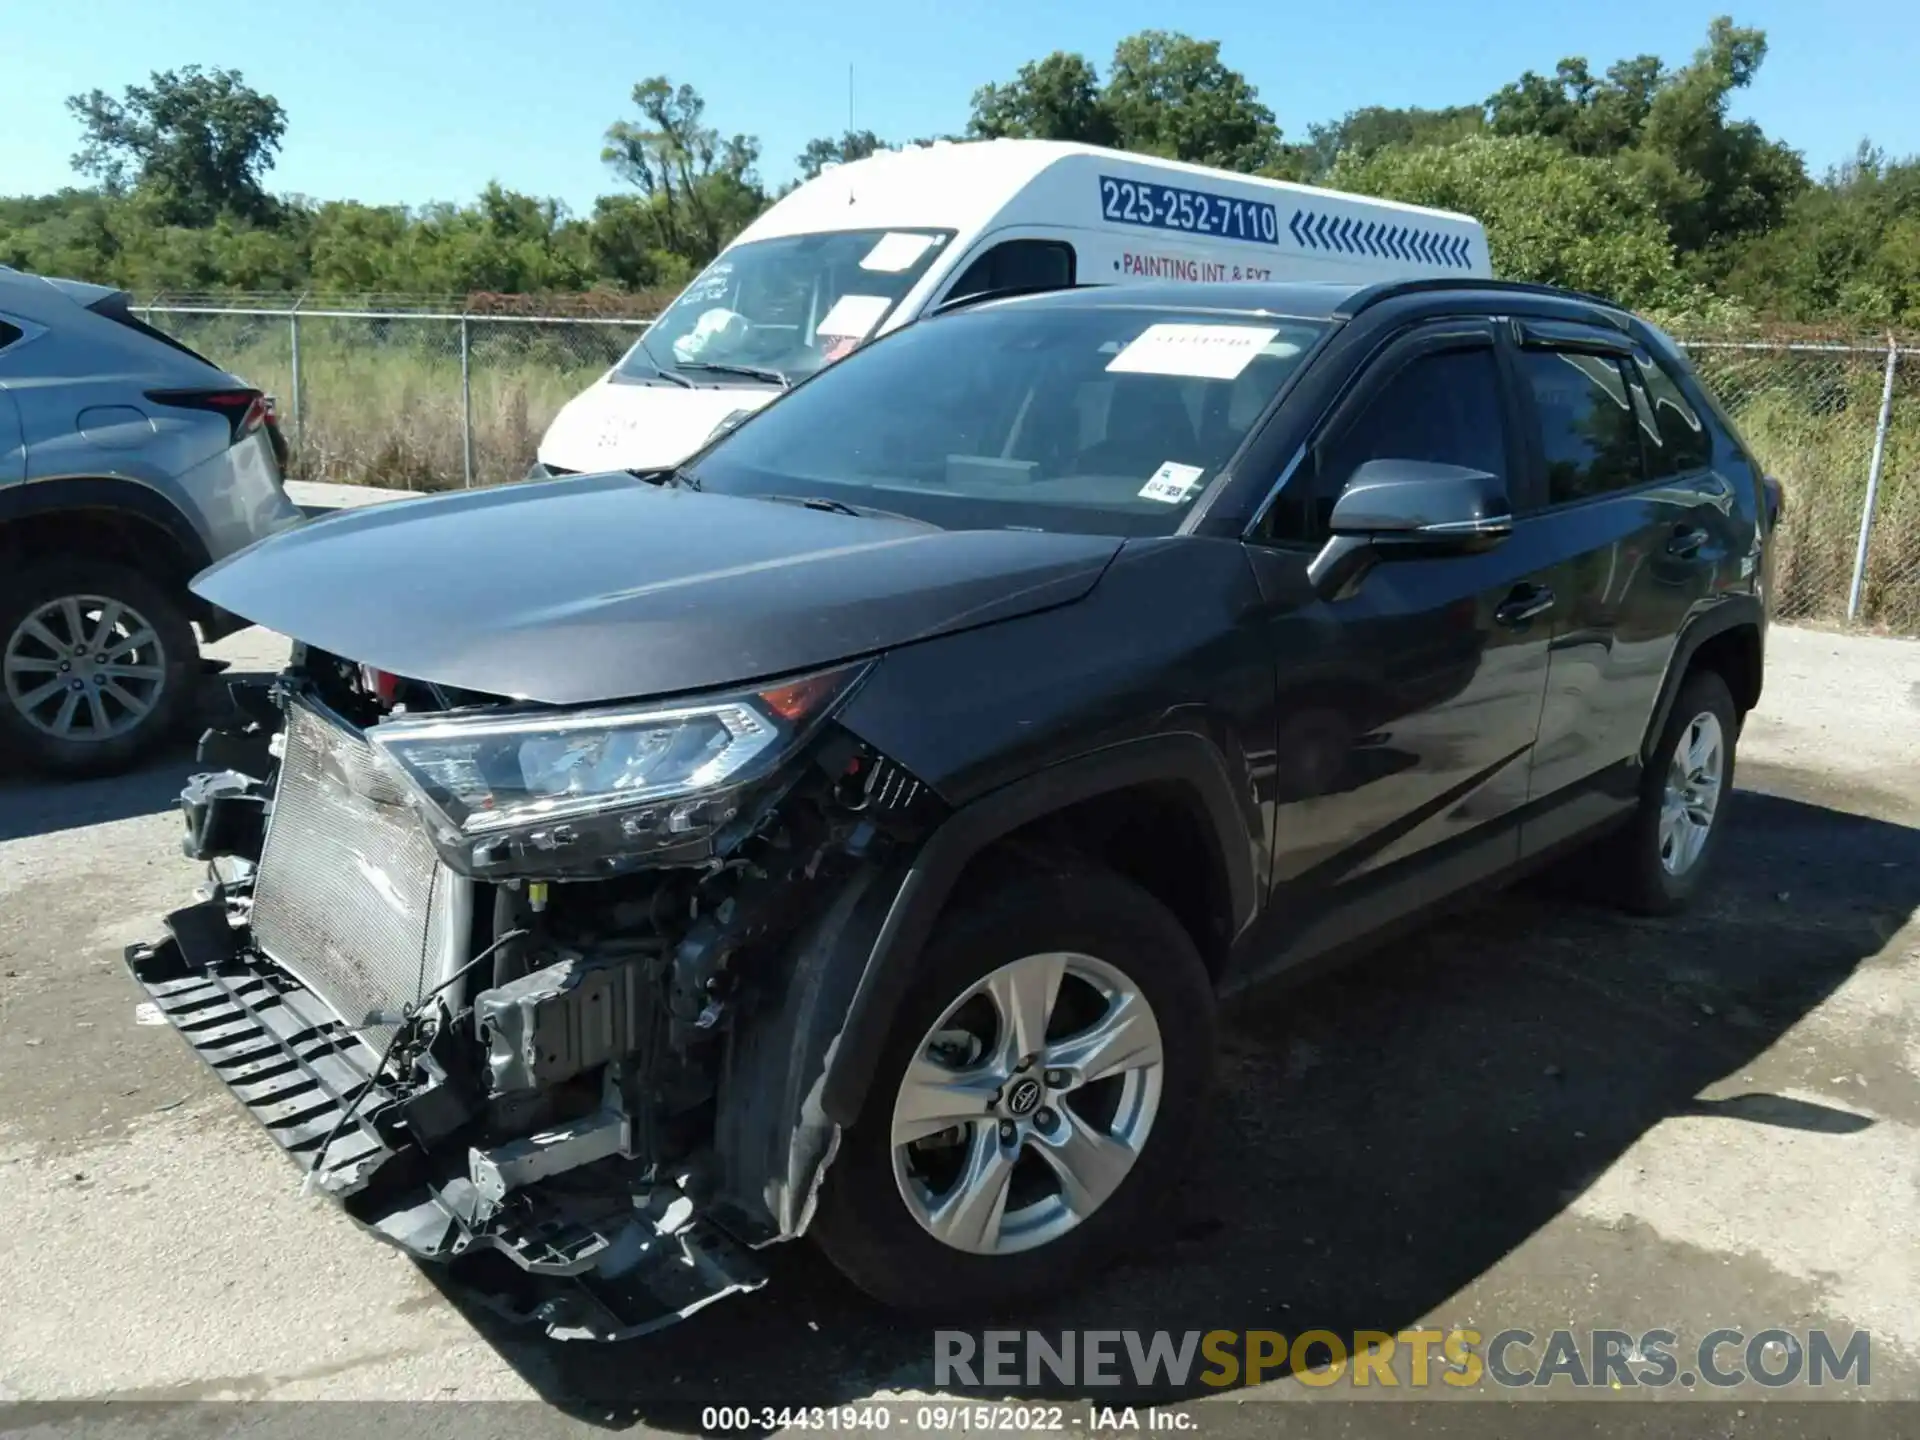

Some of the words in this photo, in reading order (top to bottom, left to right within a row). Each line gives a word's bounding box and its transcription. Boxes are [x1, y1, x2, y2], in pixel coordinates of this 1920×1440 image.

[1103, 181, 1275, 240] 225-252-7110
[1123, 253, 1198, 282] PAINTING
[1231, 265, 1242, 281] &
